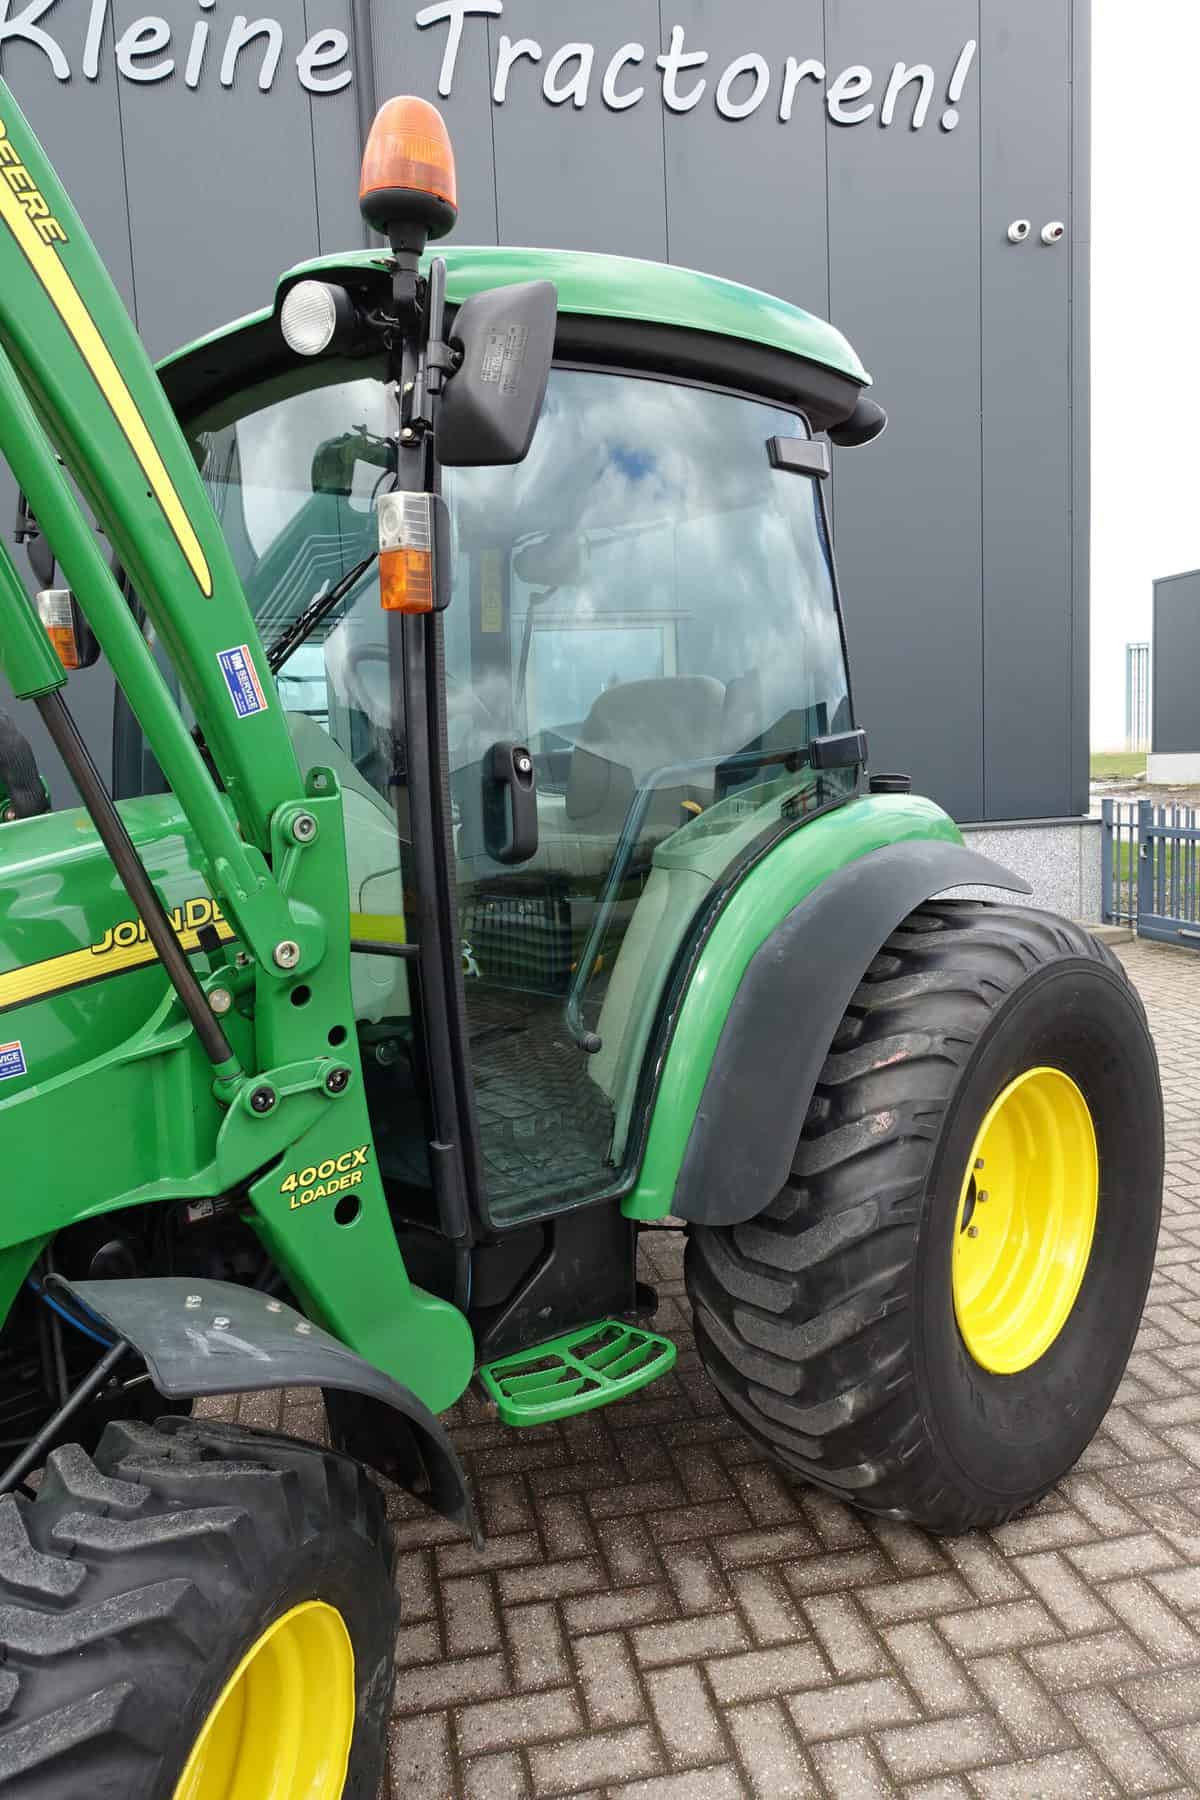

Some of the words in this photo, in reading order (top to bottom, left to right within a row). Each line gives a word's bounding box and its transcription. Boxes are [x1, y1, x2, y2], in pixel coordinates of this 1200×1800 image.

[0, 0, 352, 93] Kleine
[415, 0, 976, 130] Tractoren!
[0, 119, 69, 245] EERE
[239, 669, 258, 708] SERVICE
[280, 1144, 370, 1193] 400CX
[289, 1170, 363, 1211] LOADER
